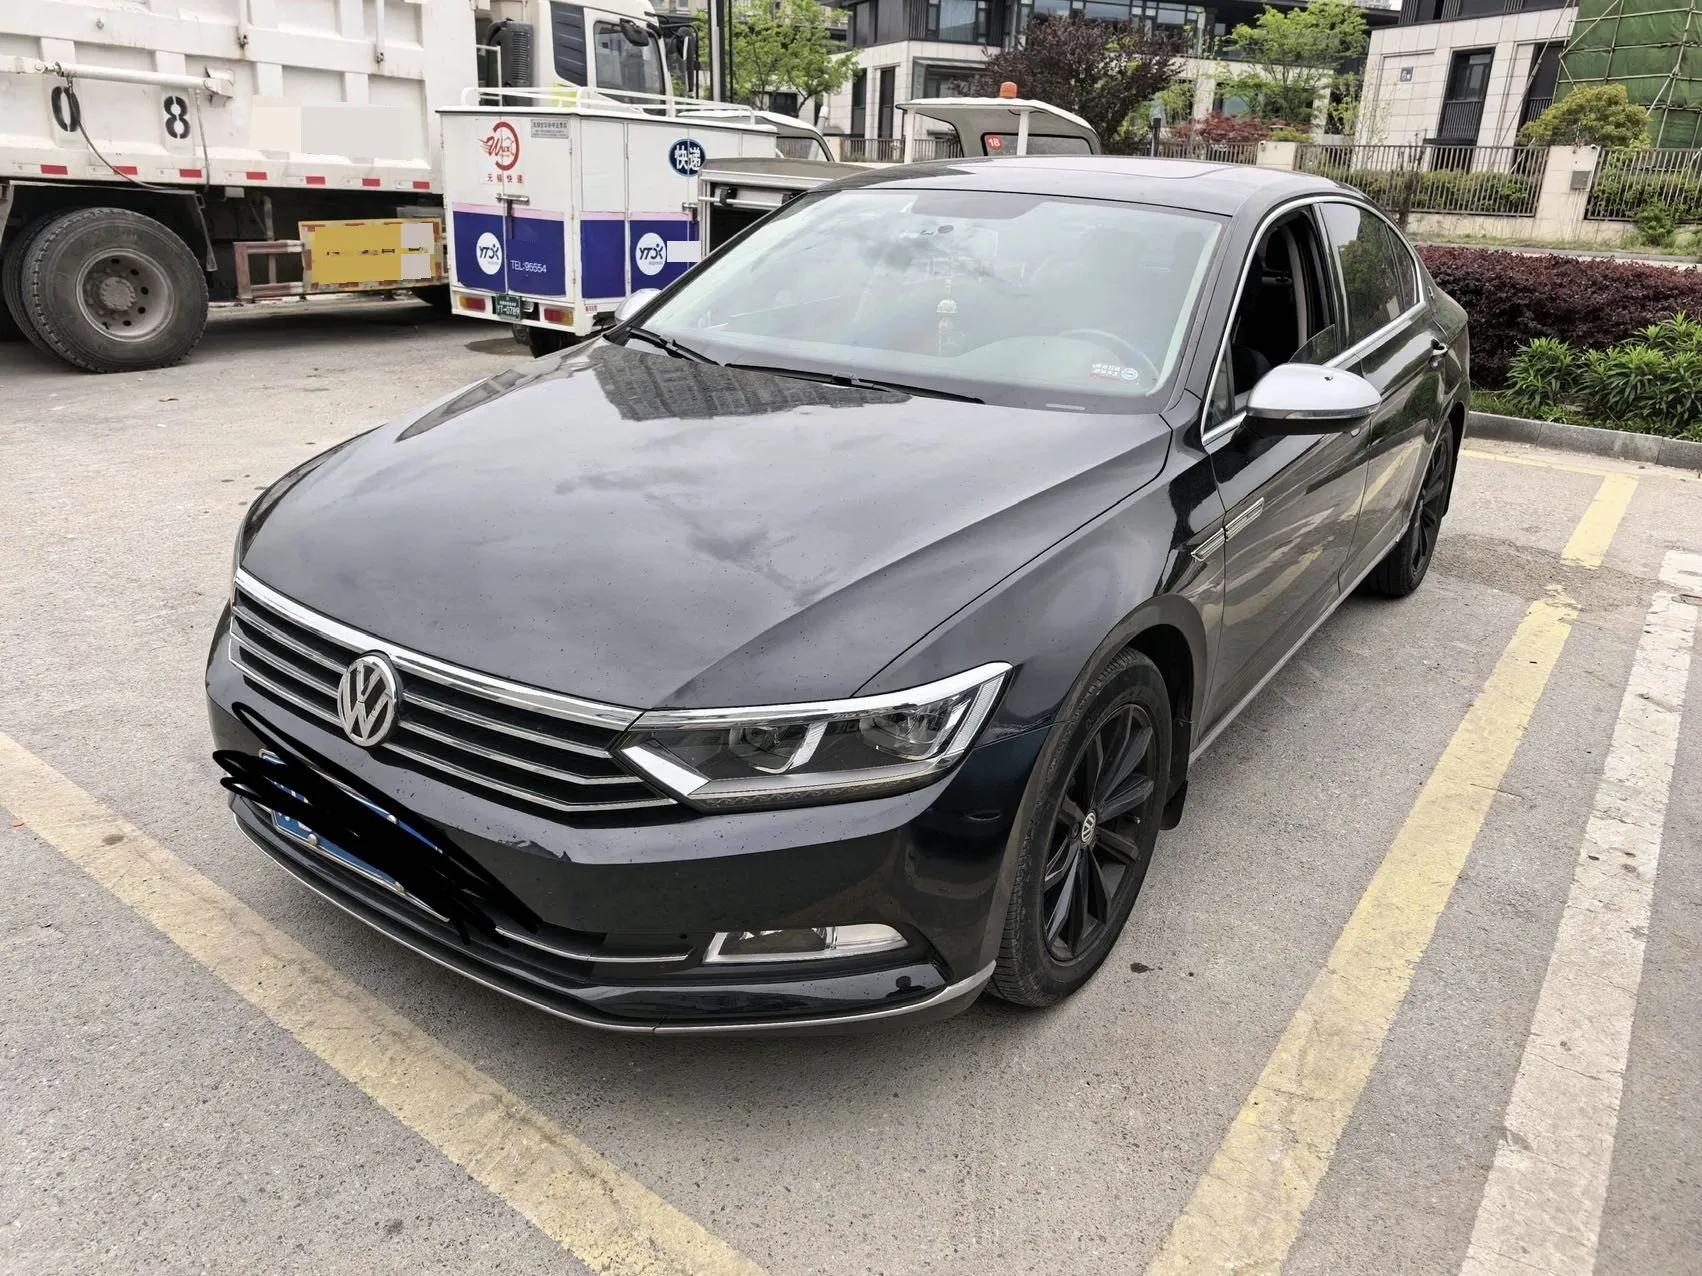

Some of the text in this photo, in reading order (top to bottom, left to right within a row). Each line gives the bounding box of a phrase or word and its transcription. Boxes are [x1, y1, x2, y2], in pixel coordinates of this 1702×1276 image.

[51, 86, 191, 139] 0 8
[988, 138, 1001, 147] 18
[674, 144, 701, 170] 快递
